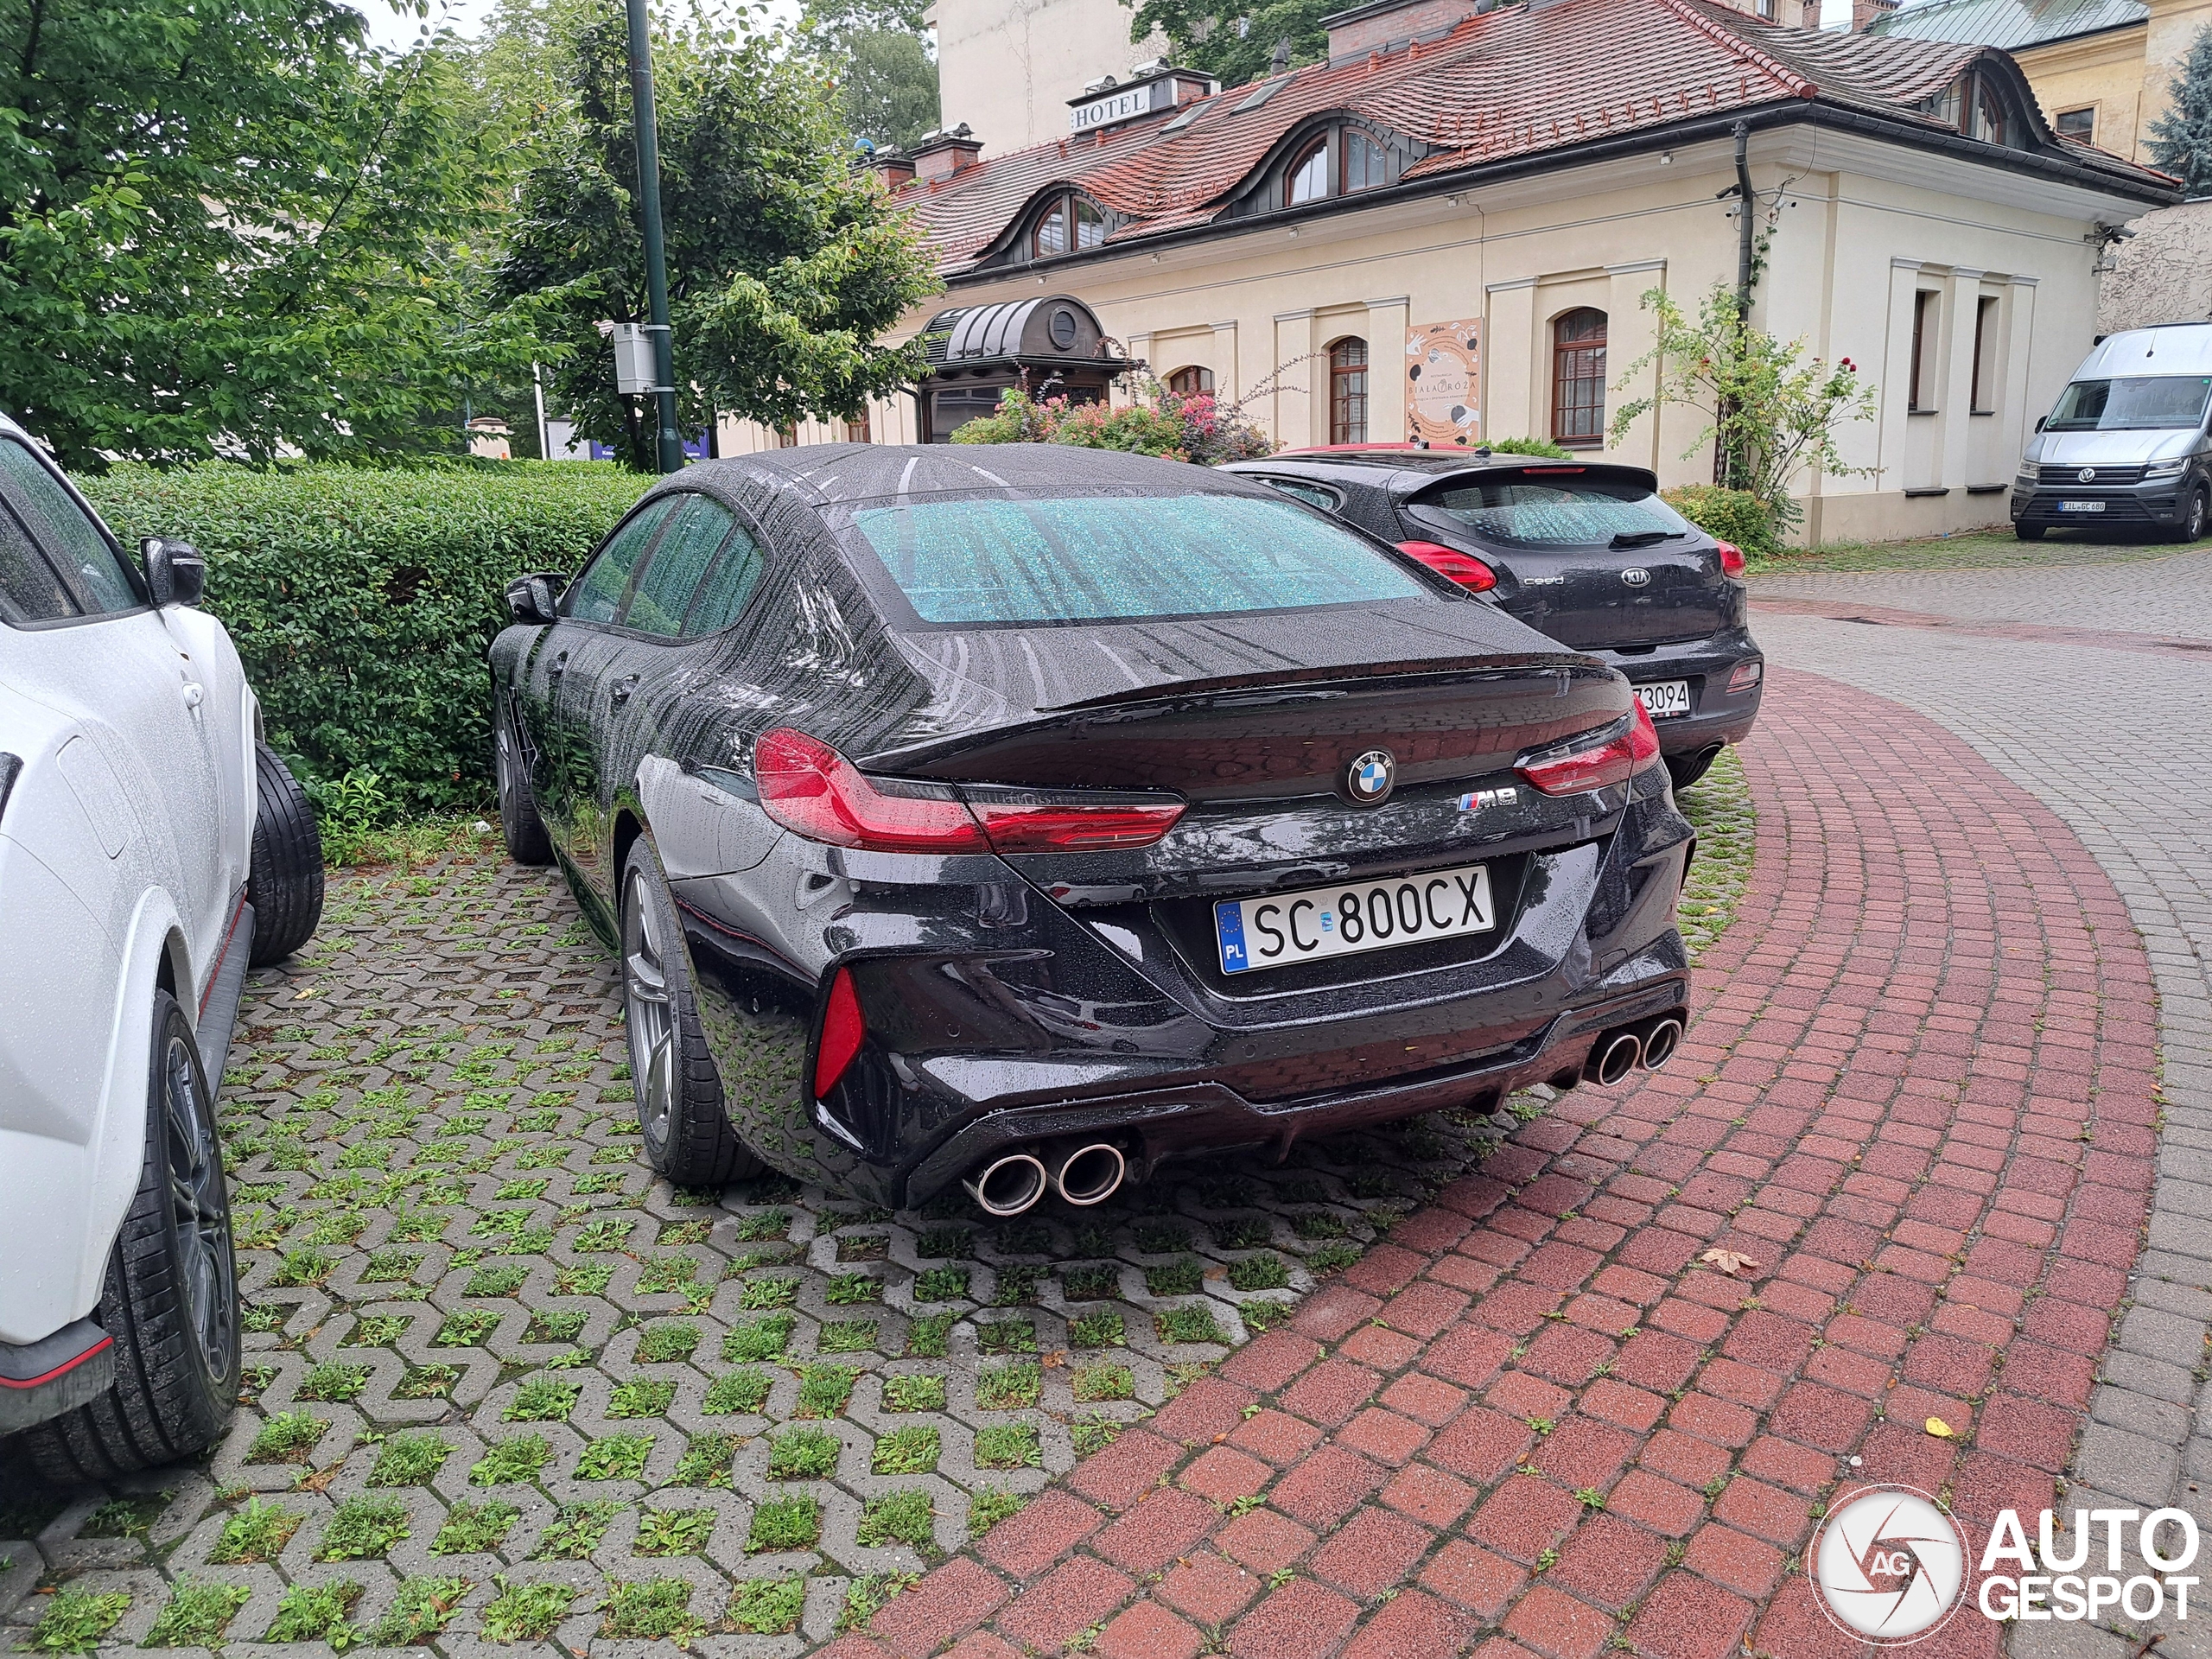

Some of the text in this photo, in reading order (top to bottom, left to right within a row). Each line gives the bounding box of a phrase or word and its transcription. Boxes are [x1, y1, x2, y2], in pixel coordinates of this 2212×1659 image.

[1075, 92, 1147, 129] HOTEL
[1408, 380, 1476, 394] BIAŁA RÓŻA
[1627, 571, 1648, 583] KIA
[1355, 753, 1393, 772] BMW
[1467, 787, 1518, 810] M8
[1253, 871, 1485, 957] SC 800CX
[1225, 943, 1244, 961] PL
